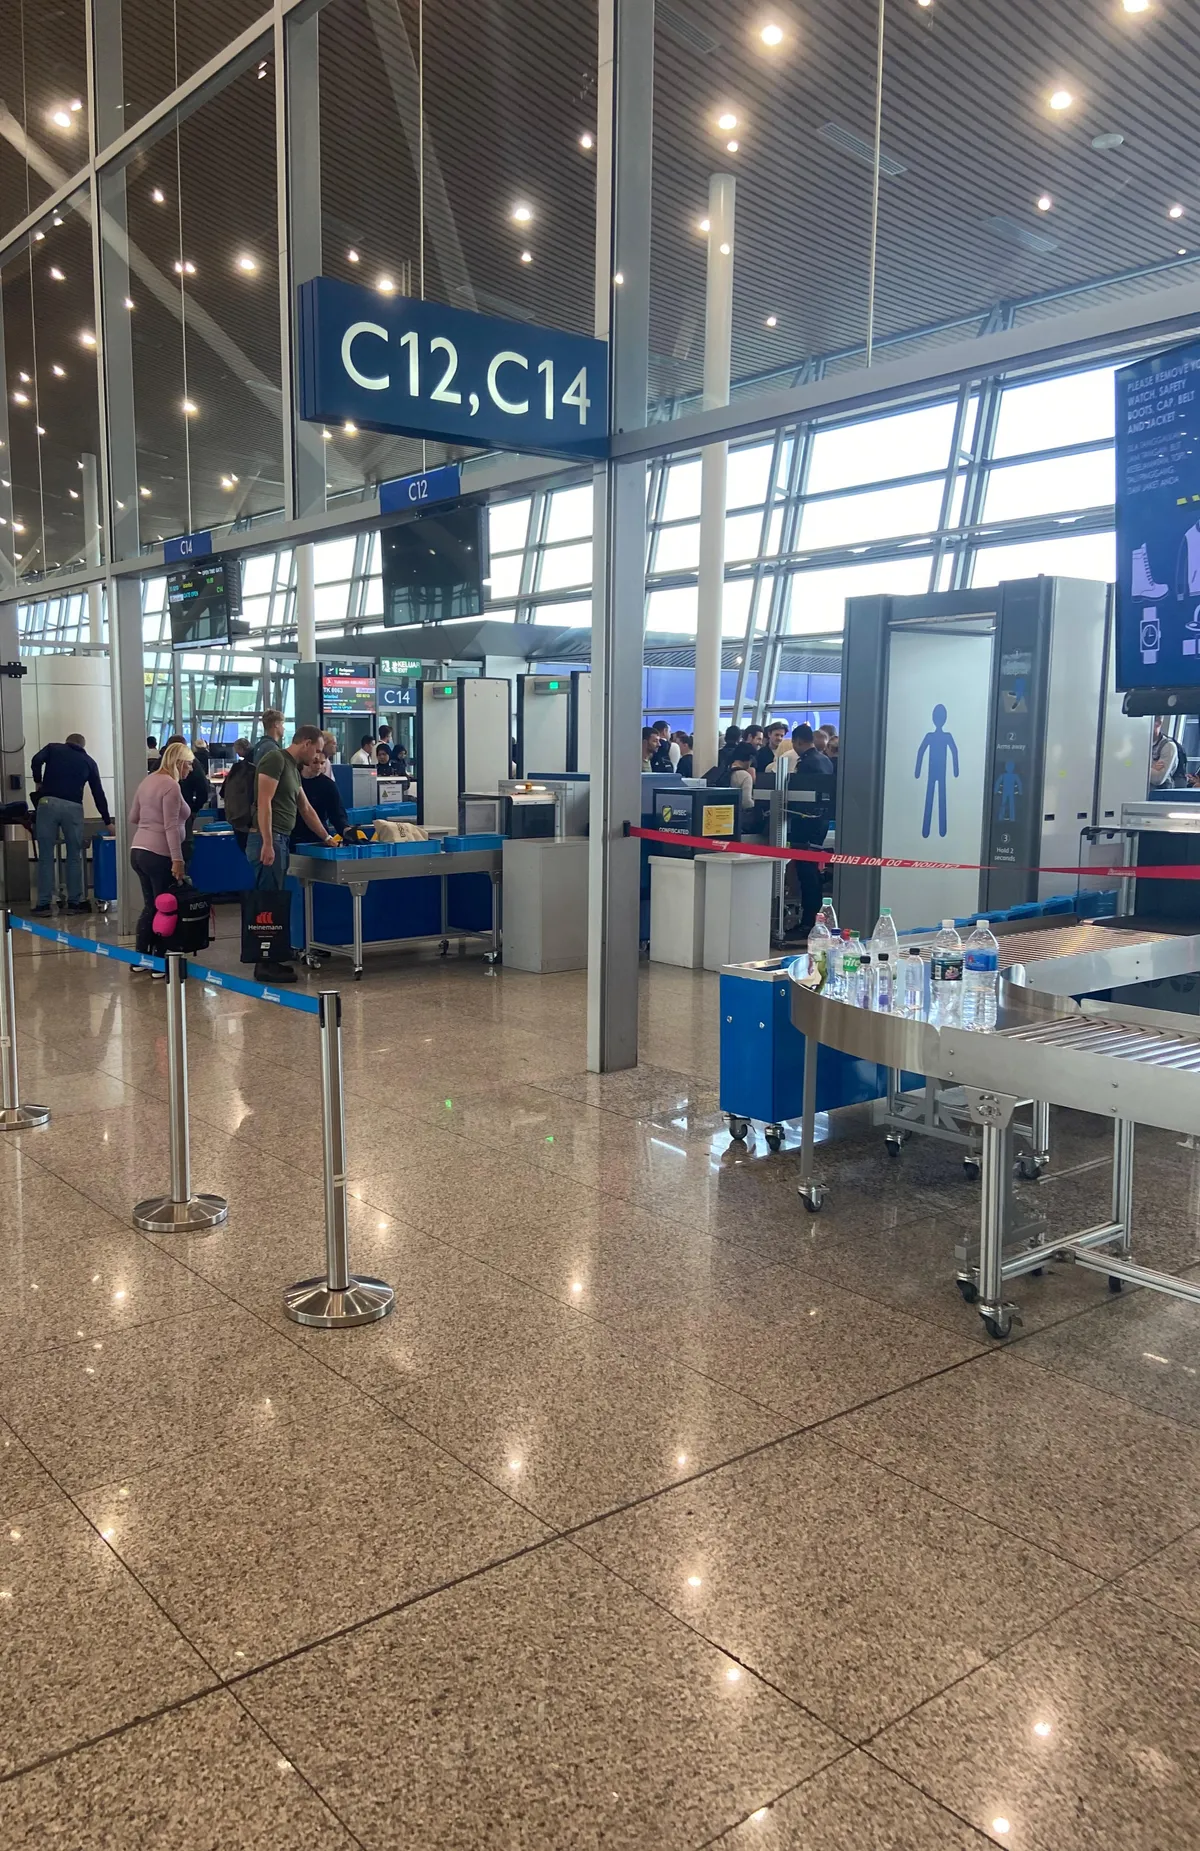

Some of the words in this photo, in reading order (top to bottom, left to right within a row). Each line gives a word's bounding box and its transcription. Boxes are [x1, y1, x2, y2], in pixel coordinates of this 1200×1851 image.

[341, 321, 591, 425] C12,C14
[1128, 375, 1153, 392] PLEASE
[1155, 363, 1188, 383] REMOVE
[1159, 379, 1186, 396] SAFETY
[1178, 390, 1195, 404] BELT
[1128, 421, 1145, 434] AND
[1146, 411, 1175, 429] JACKET
[408, 480, 428, 501] C12
[180, 540, 193, 555] C14
[384, 690, 411, 704] C14
[1012, 744, 1026, 752] away
[830, 853, 861, 865] ENTER
[861, 856, 885, 866] NOT
[886, 859, 901, 867] DO
